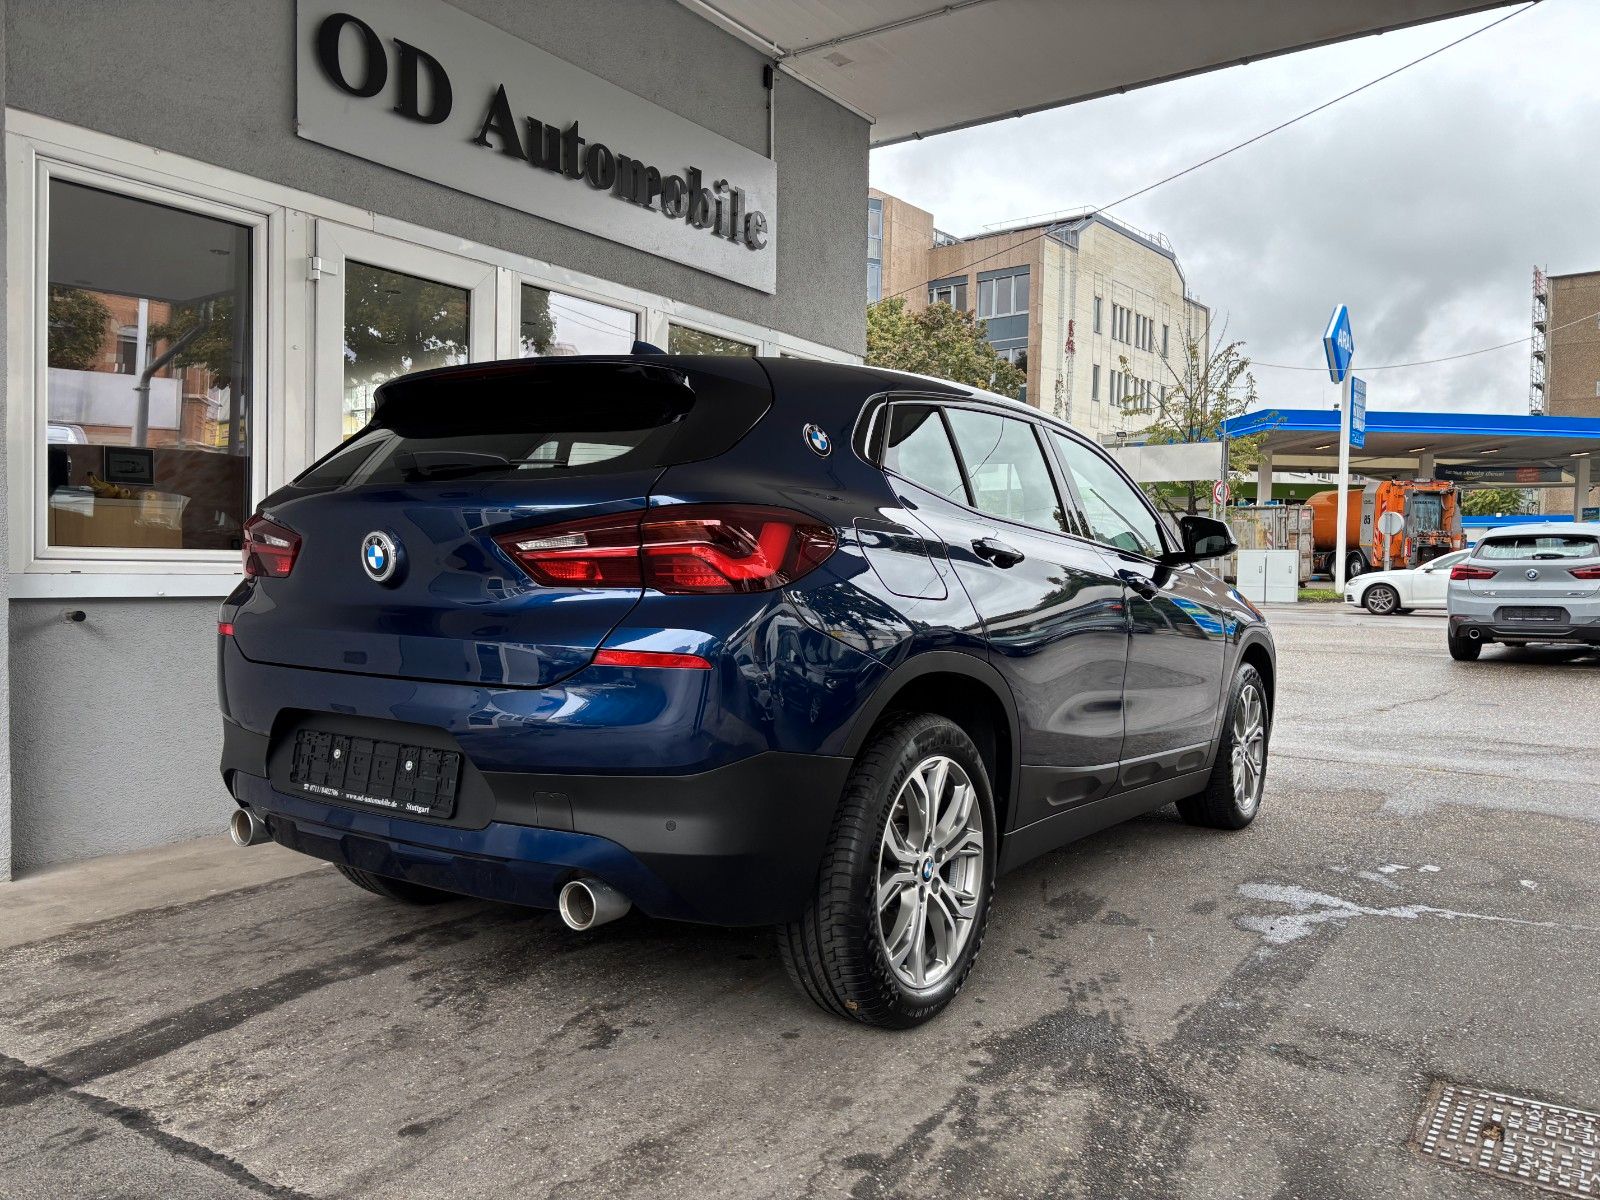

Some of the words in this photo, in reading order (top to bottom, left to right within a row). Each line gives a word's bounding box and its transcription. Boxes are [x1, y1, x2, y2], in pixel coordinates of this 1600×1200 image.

[318, 12, 453, 125] OD
[473, 83, 768, 251] Automobile
[405, 802, 430, 814] Stuttgart
[1512, 1132, 1600, 1159] RLICH
